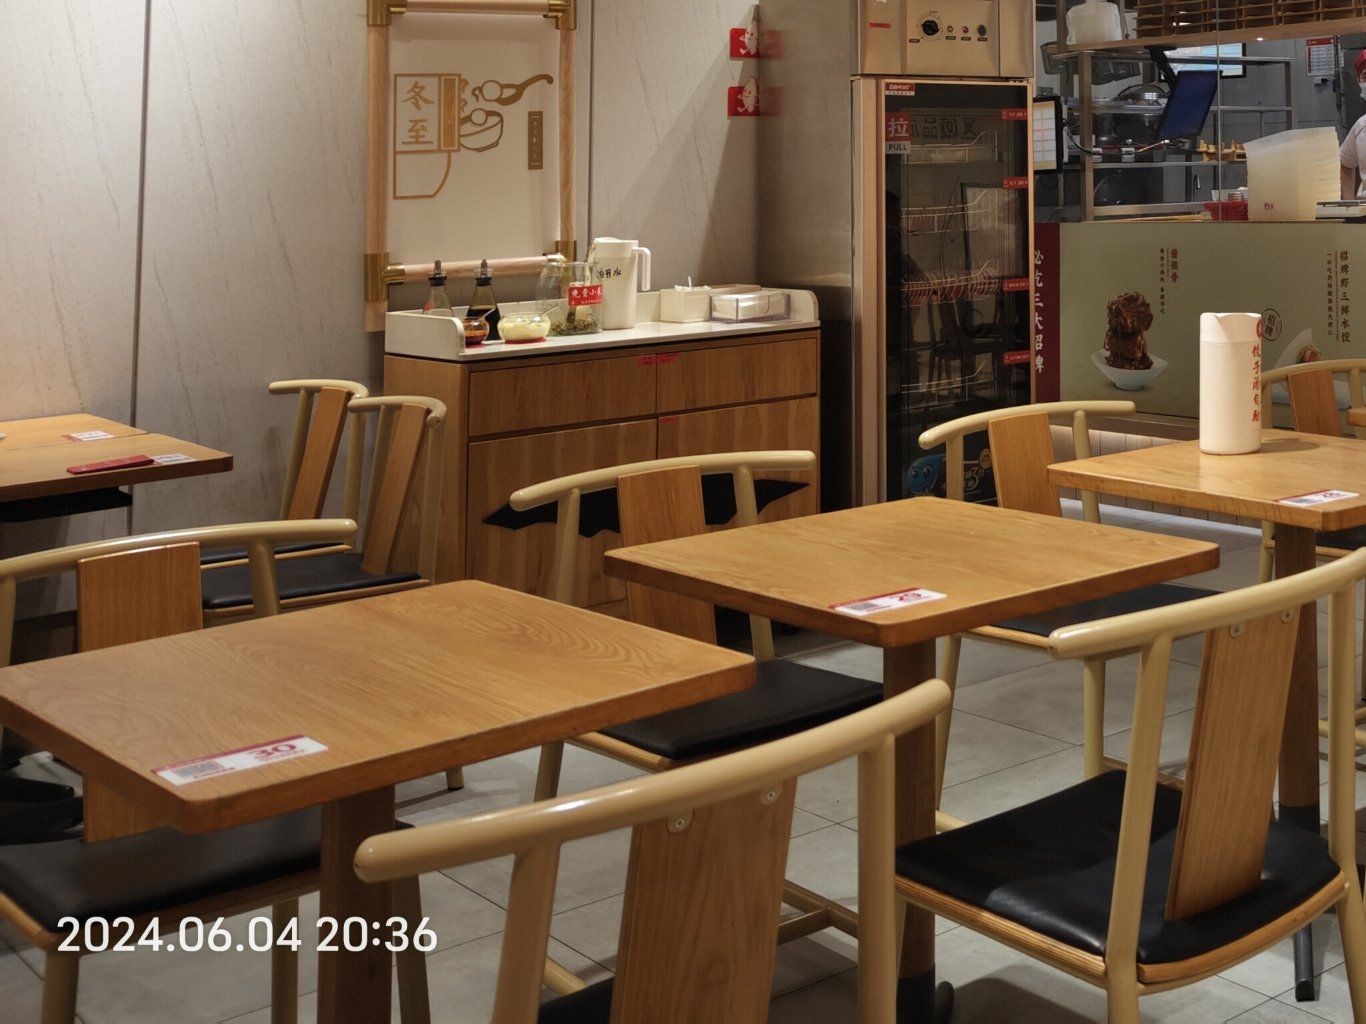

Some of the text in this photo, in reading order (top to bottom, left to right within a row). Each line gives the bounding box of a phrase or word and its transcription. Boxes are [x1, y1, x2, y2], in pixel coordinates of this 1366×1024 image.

[401, 80, 435, 145] 冬至
[888, 117, 909, 138] 拉
[888, 143, 908, 153] PULL
[1339, 250, 1351, 343] 招牌虾三鲜水饺
[1265, 314, 1277, 337] 招牌
